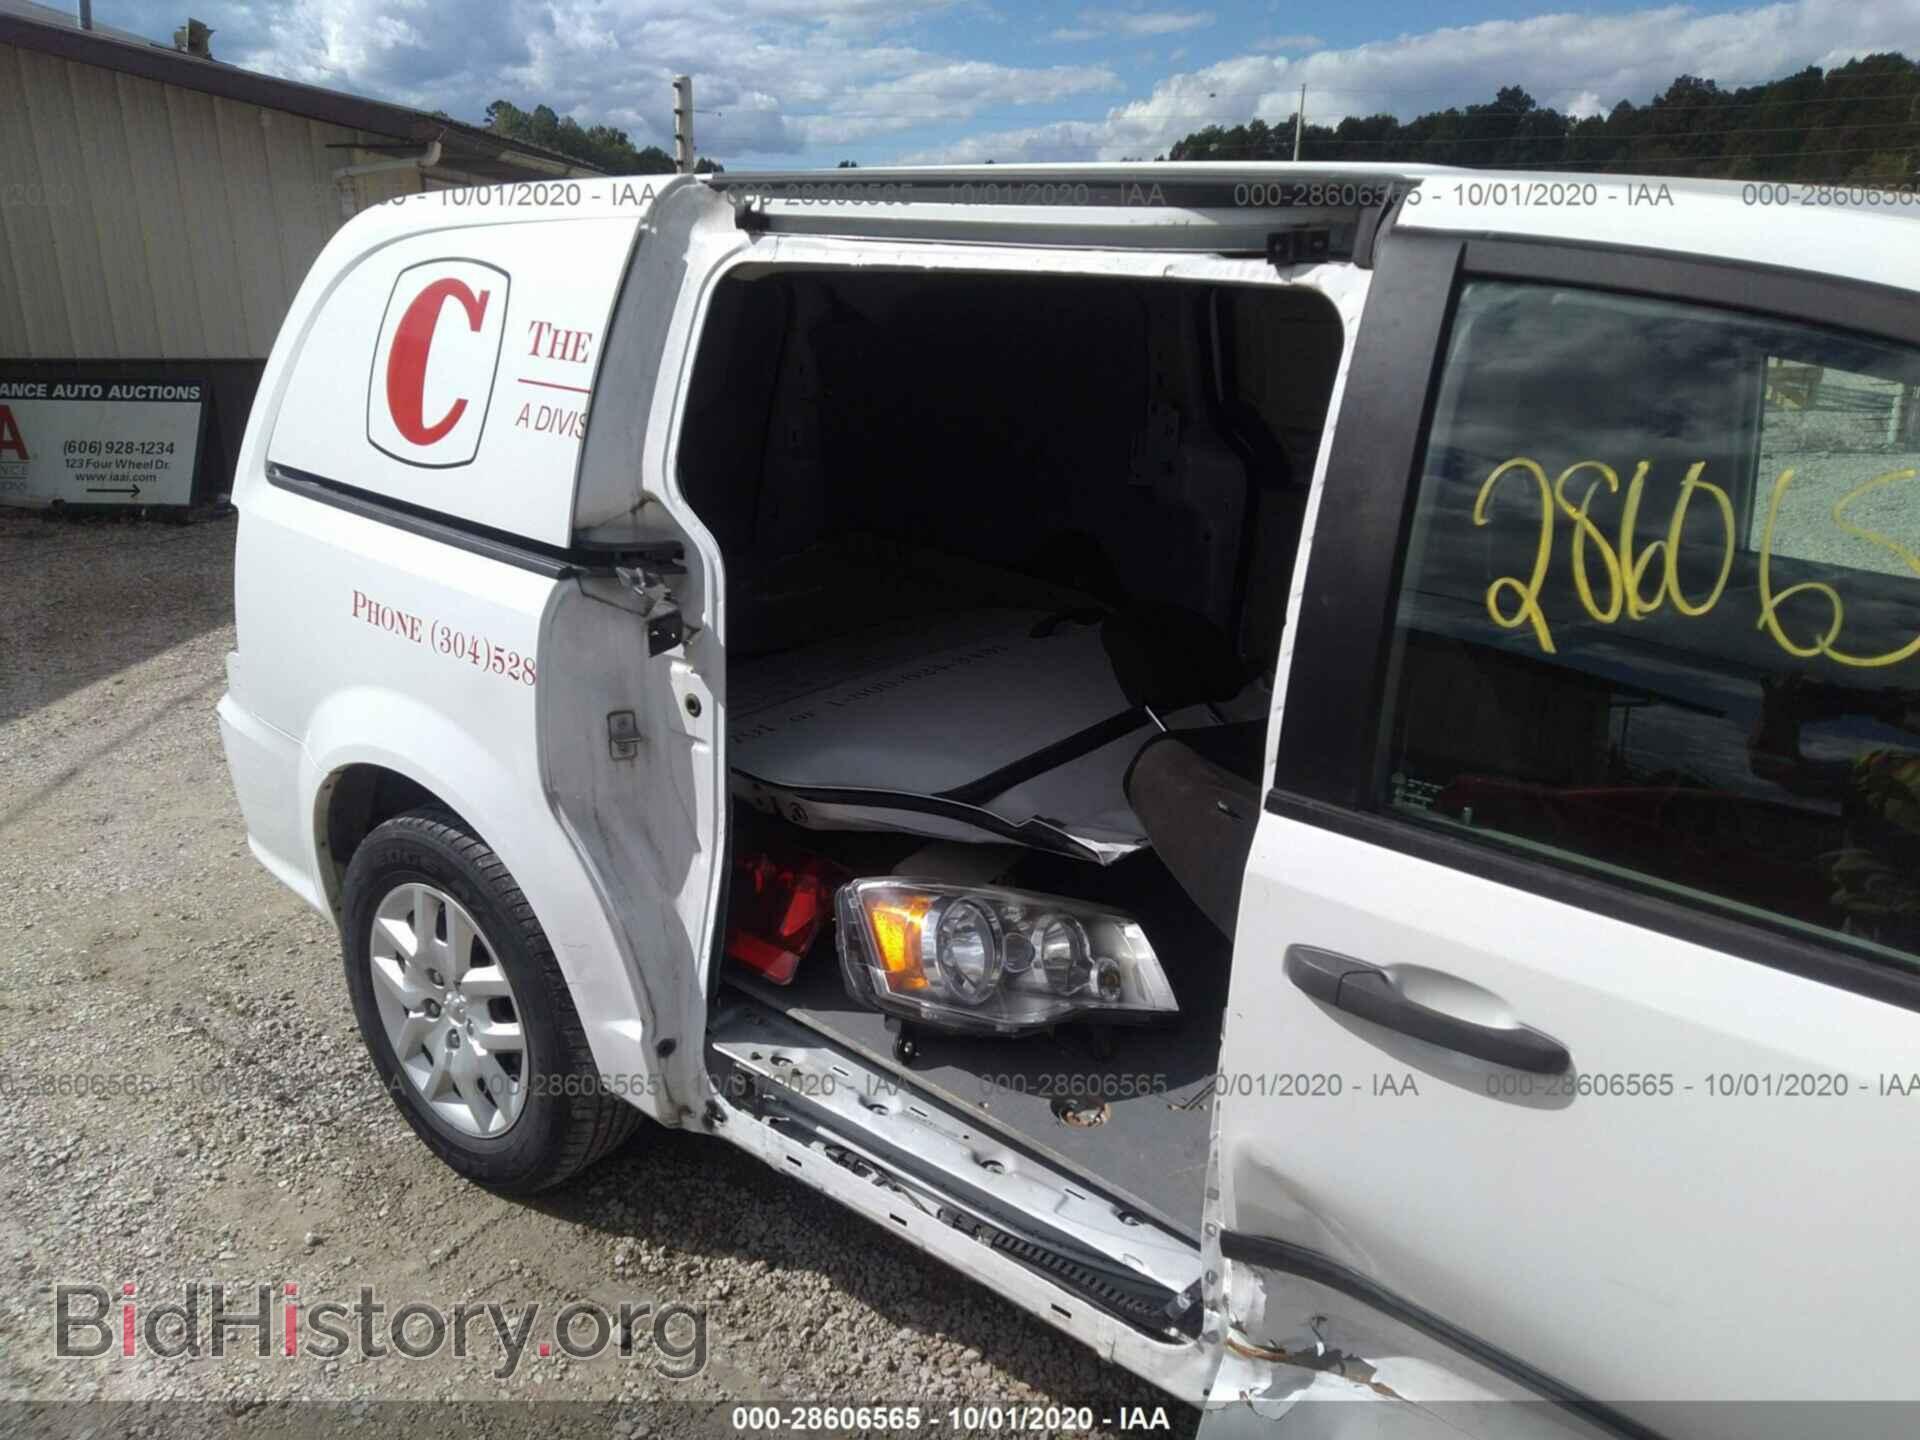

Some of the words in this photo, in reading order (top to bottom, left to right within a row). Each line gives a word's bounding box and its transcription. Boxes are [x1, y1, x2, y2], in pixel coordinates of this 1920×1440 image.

[386, 276, 491, 447] C
[0, 383, 47, 398] ANCE
[52, 384, 103, 398] AUTO
[108, 385, 200, 400] AUCTIONS
[515, 403, 531, 428] A
[534, 408, 590, 441] DIVIS
[63, 439, 102, 456] (606)
[105, 441, 175, 455] 928-1234
[65, 458, 84, 469] 123
[86, 459, 113, 470] Four
[115, 459, 153, 470] Wheel
[75, 472, 157, 483] www.iaai.com
